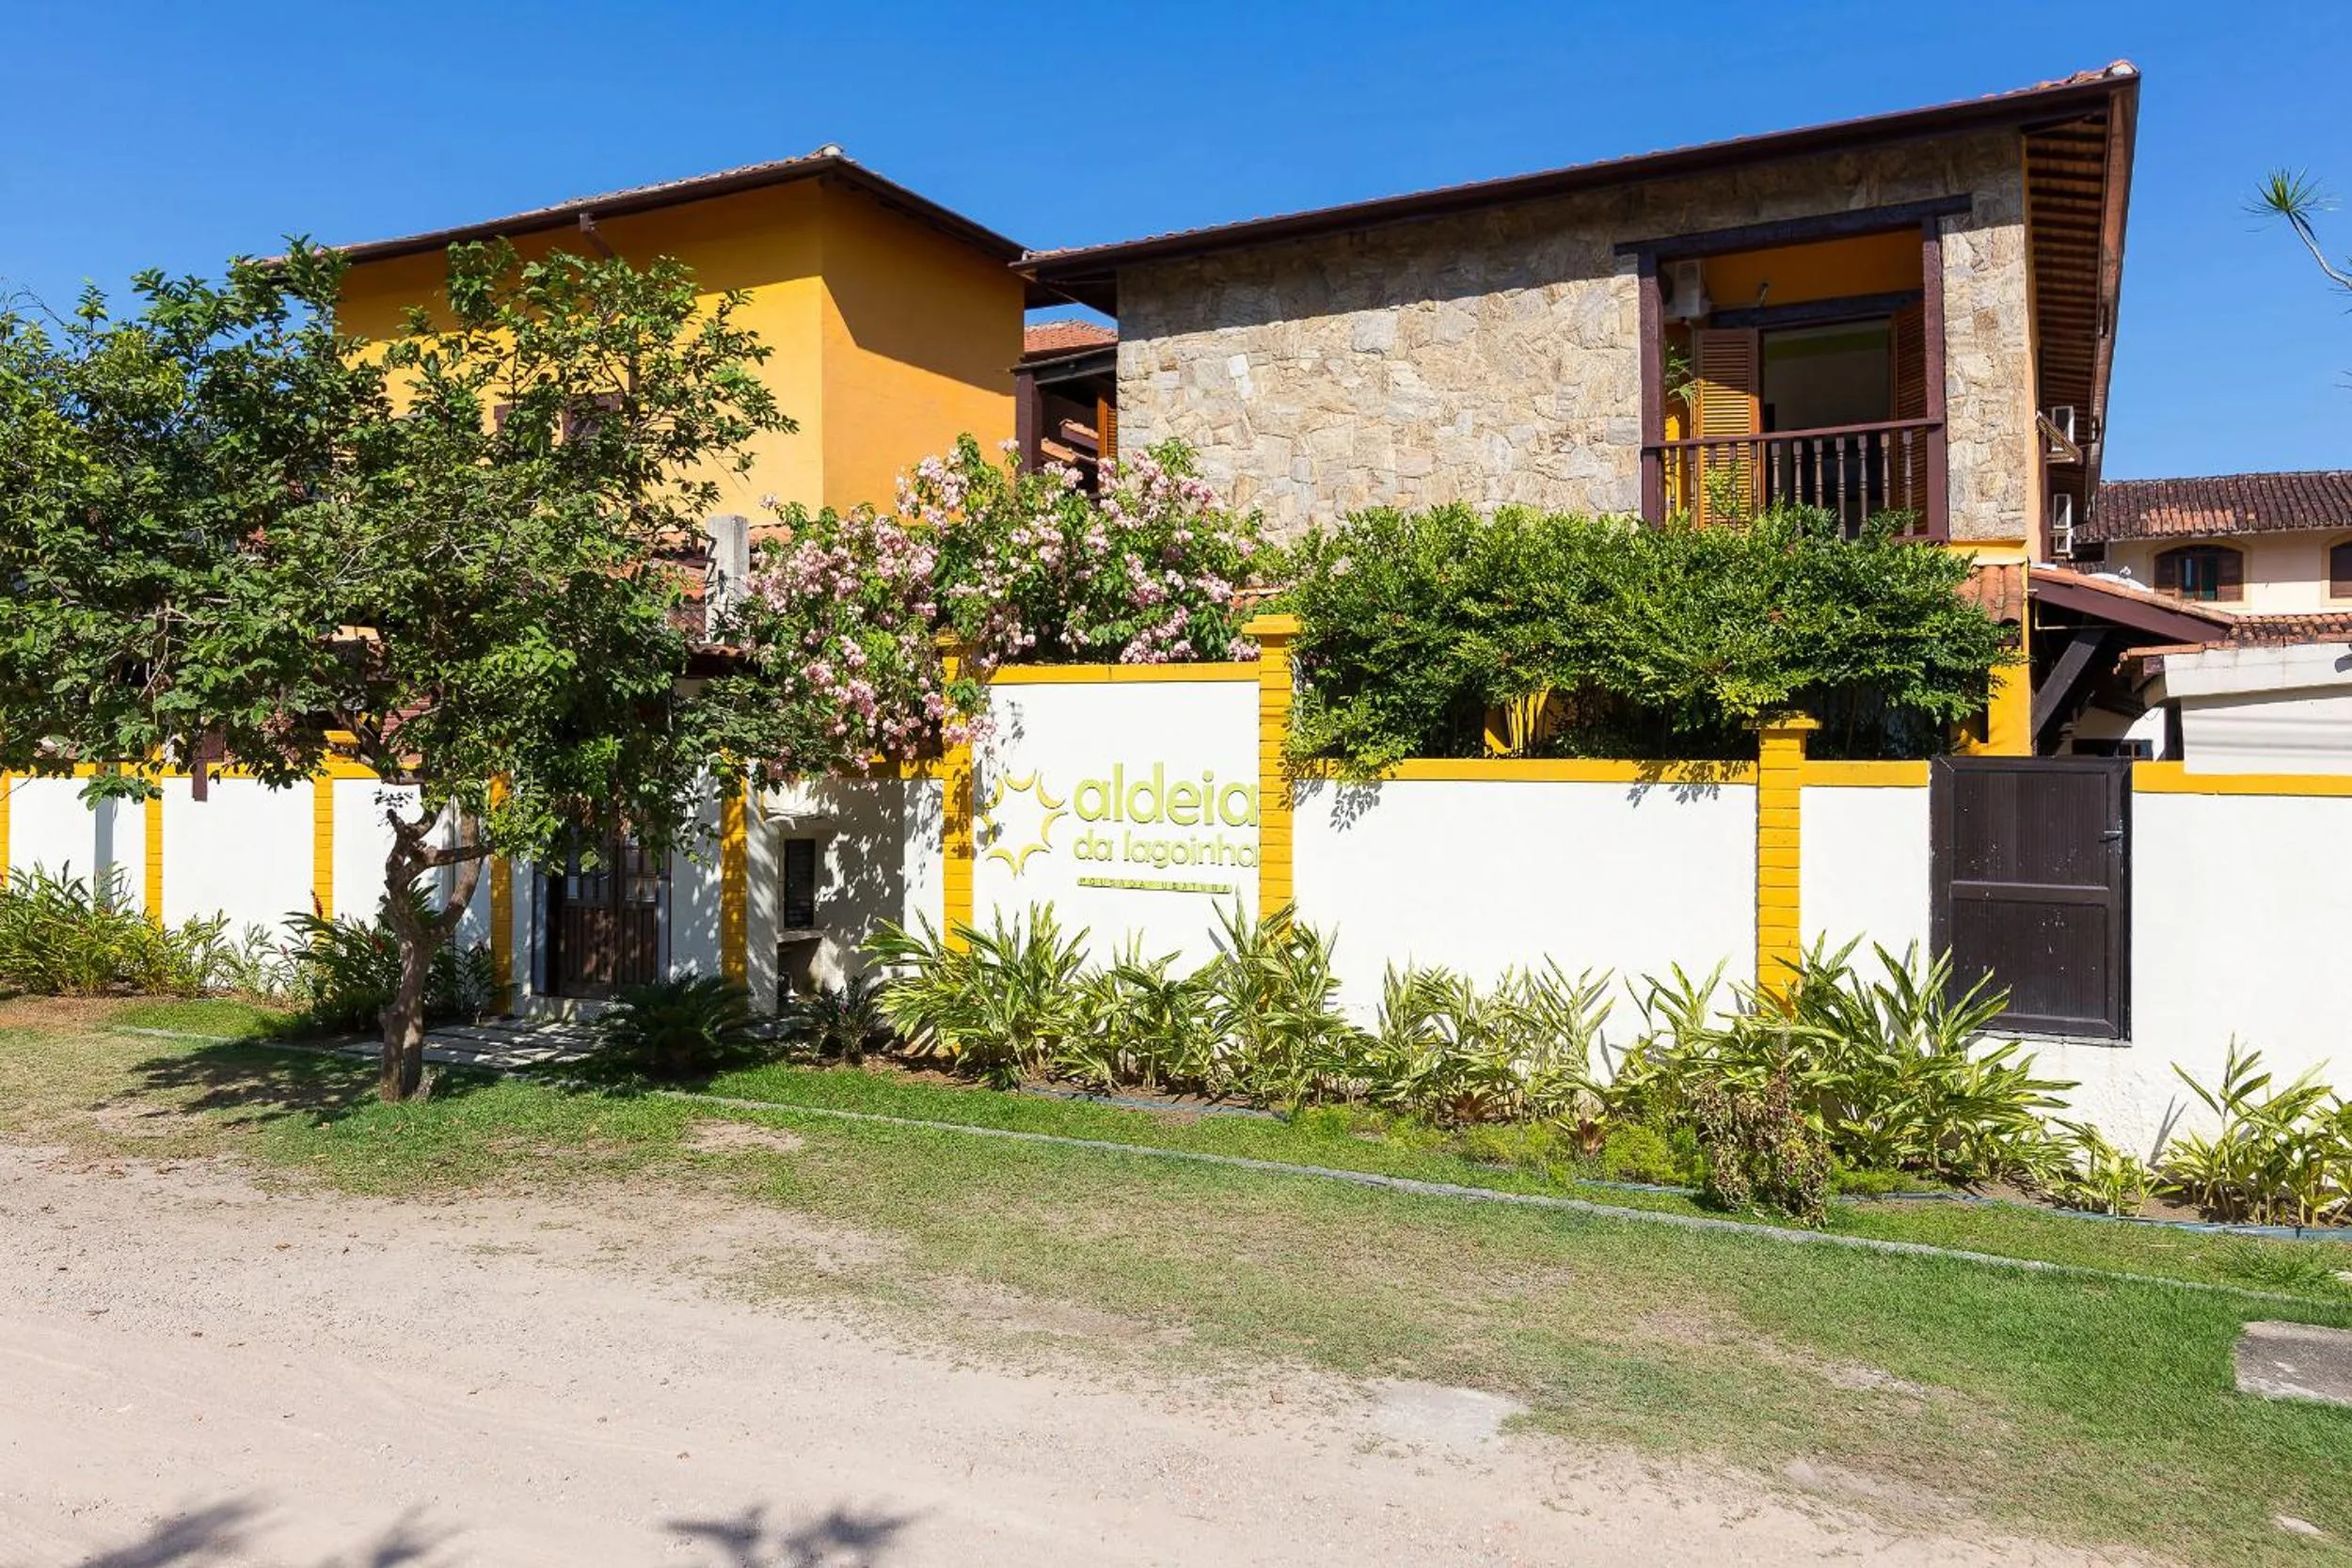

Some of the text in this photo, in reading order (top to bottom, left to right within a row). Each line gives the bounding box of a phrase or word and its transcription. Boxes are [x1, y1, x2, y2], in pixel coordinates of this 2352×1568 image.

[1073, 762, 1258, 826] aldeia
[1073, 830, 1258, 868] da lagoinha
